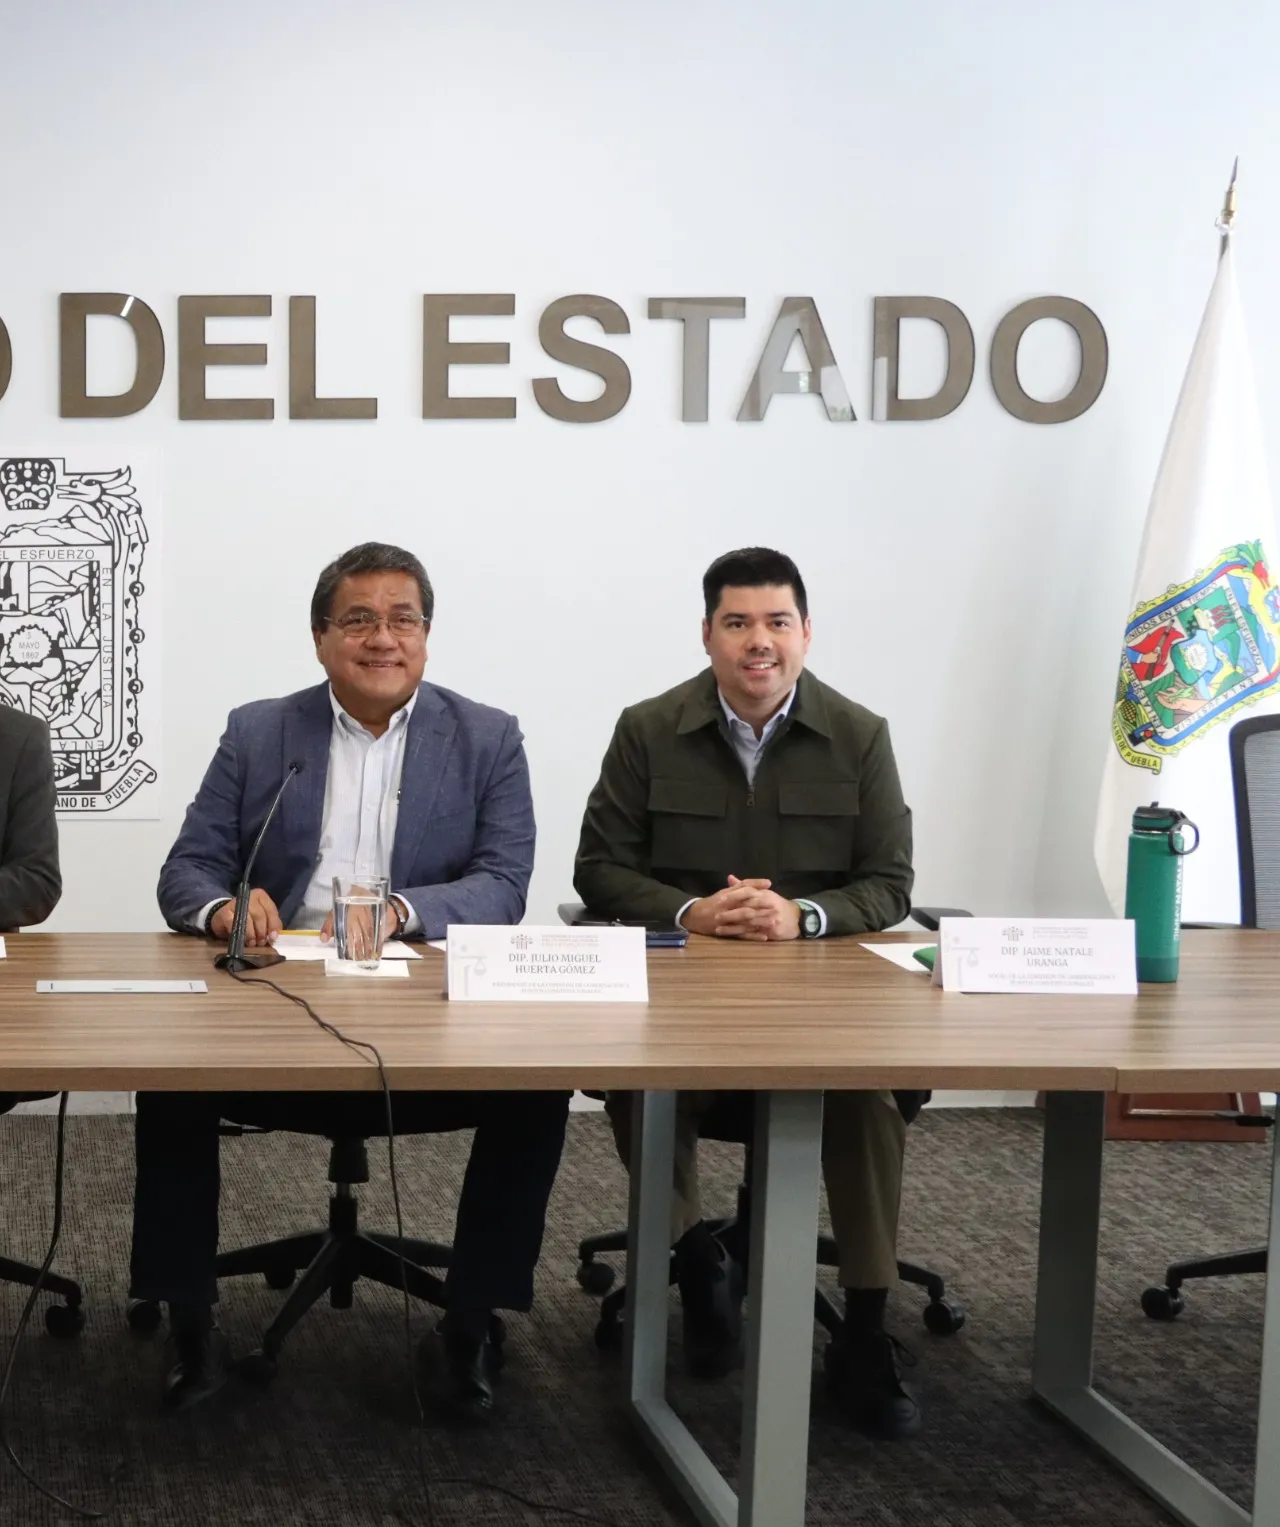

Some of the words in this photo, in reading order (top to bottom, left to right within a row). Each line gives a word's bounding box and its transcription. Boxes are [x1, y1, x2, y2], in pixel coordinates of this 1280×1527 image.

[58, 292, 378, 421] DEL
[423, 293, 1109, 425] ESTADO
[20, 549, 95, 560] ESFUERZO
[102, 567, 112, 587] EN
[102, 602, 112, 620] LA
[1158, 610, 1172, 620] EN
[102, 636, 112, 708] JUSTICIA
[1125, 751, 1158, 767] PUEBLA
[81, 797, 96, 807] DE
[105, 767, 143, 804] PUEBLA
[509, 953, 529, 963] DIP.
[531, 954, 559, 964] JULIO
[561, 954, 602, 963] MIGUEL
[1022, 947, 1053, 957] JAIME
[1054, 948, 1094, 957] NATALE
[515, 965, 557, 974] HUERTA
[558, 963, 596, 974] GÓMEZ
[1027, 958, 1069, 968] URANGA
